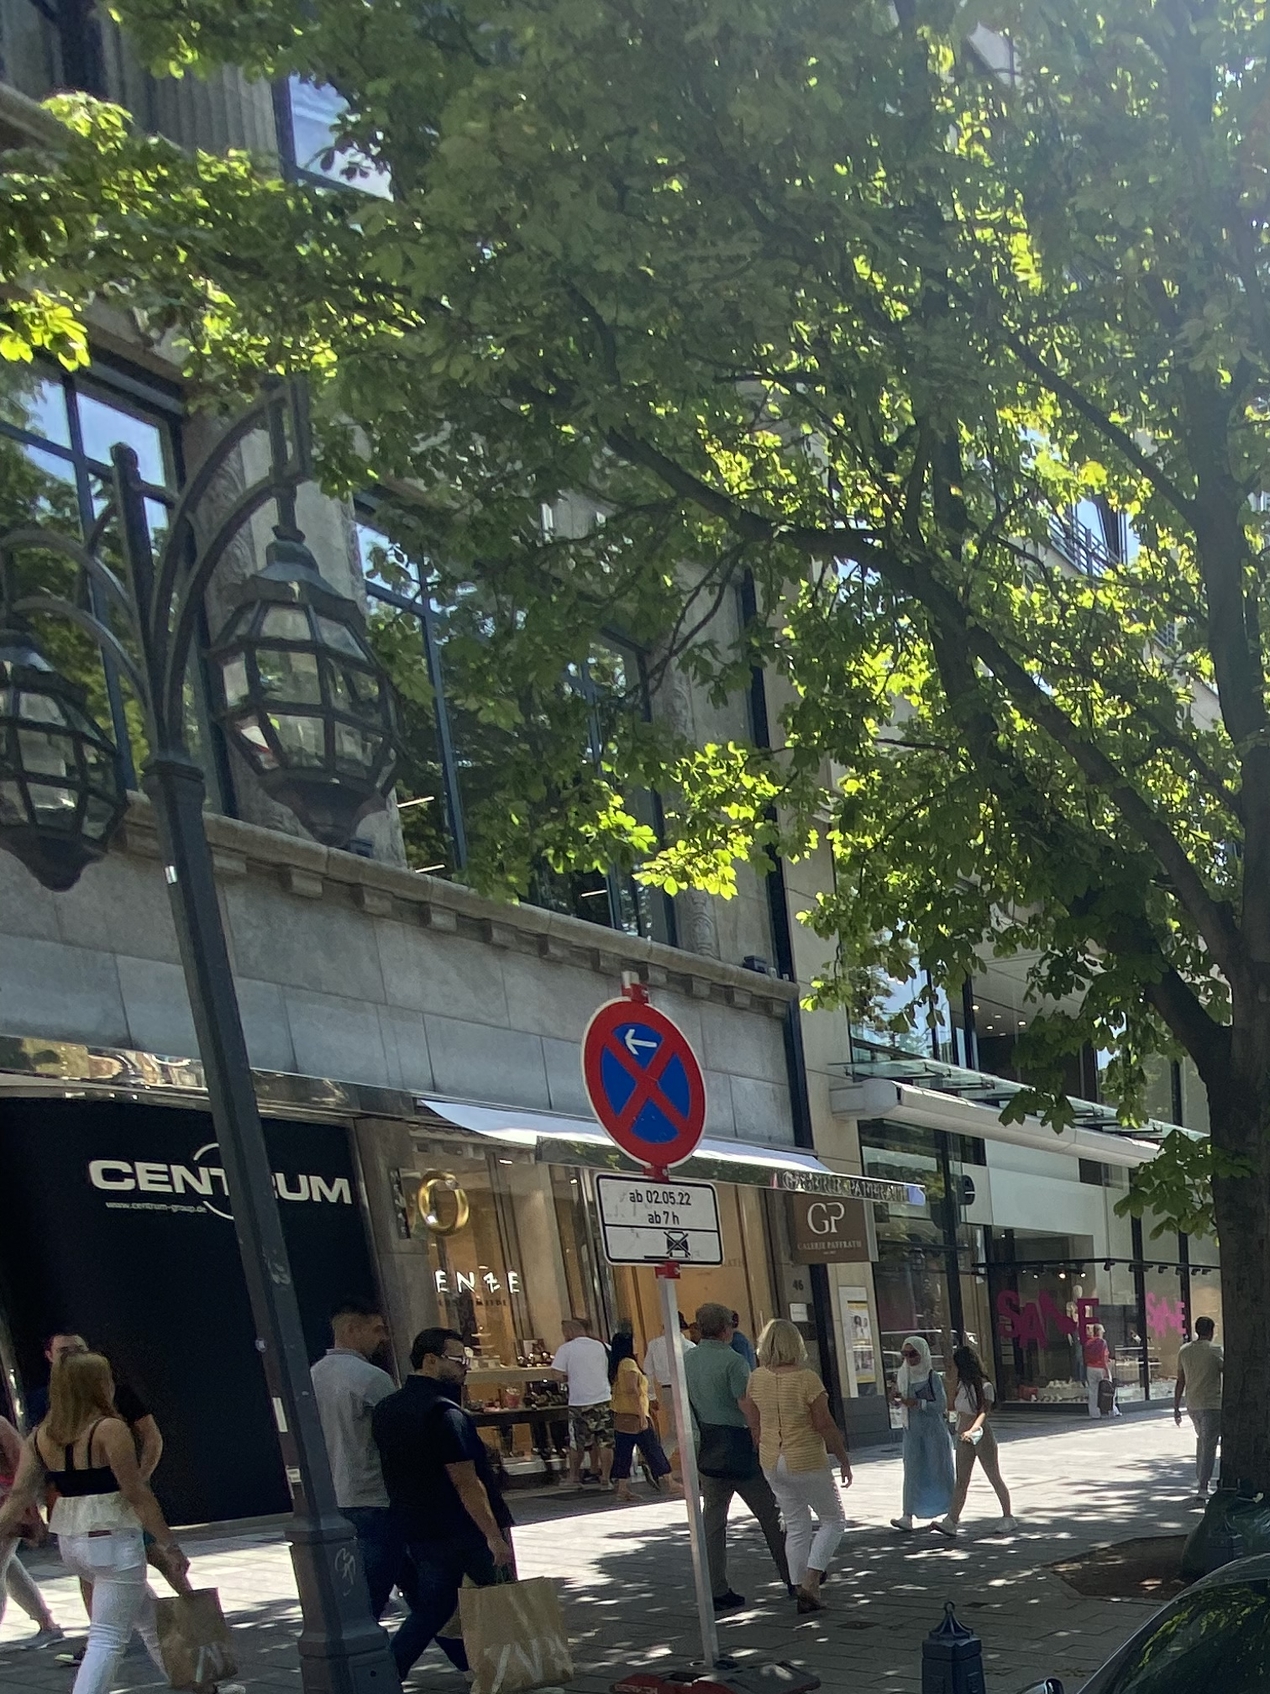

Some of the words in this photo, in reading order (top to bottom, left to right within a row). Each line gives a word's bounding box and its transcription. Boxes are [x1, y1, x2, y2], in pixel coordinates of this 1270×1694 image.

[89, 1160, 352, 1204] CENTUM
[629, 1189, 643, 1203] ab
[646, 1190, 692, 1206] 02.05.22
[648, 1211, 661, 1224] ab
[663, 1211, 669, 1225] 7
[672, 1211, 679, 1225] h
[807, 1202, 845, 1234] GP
